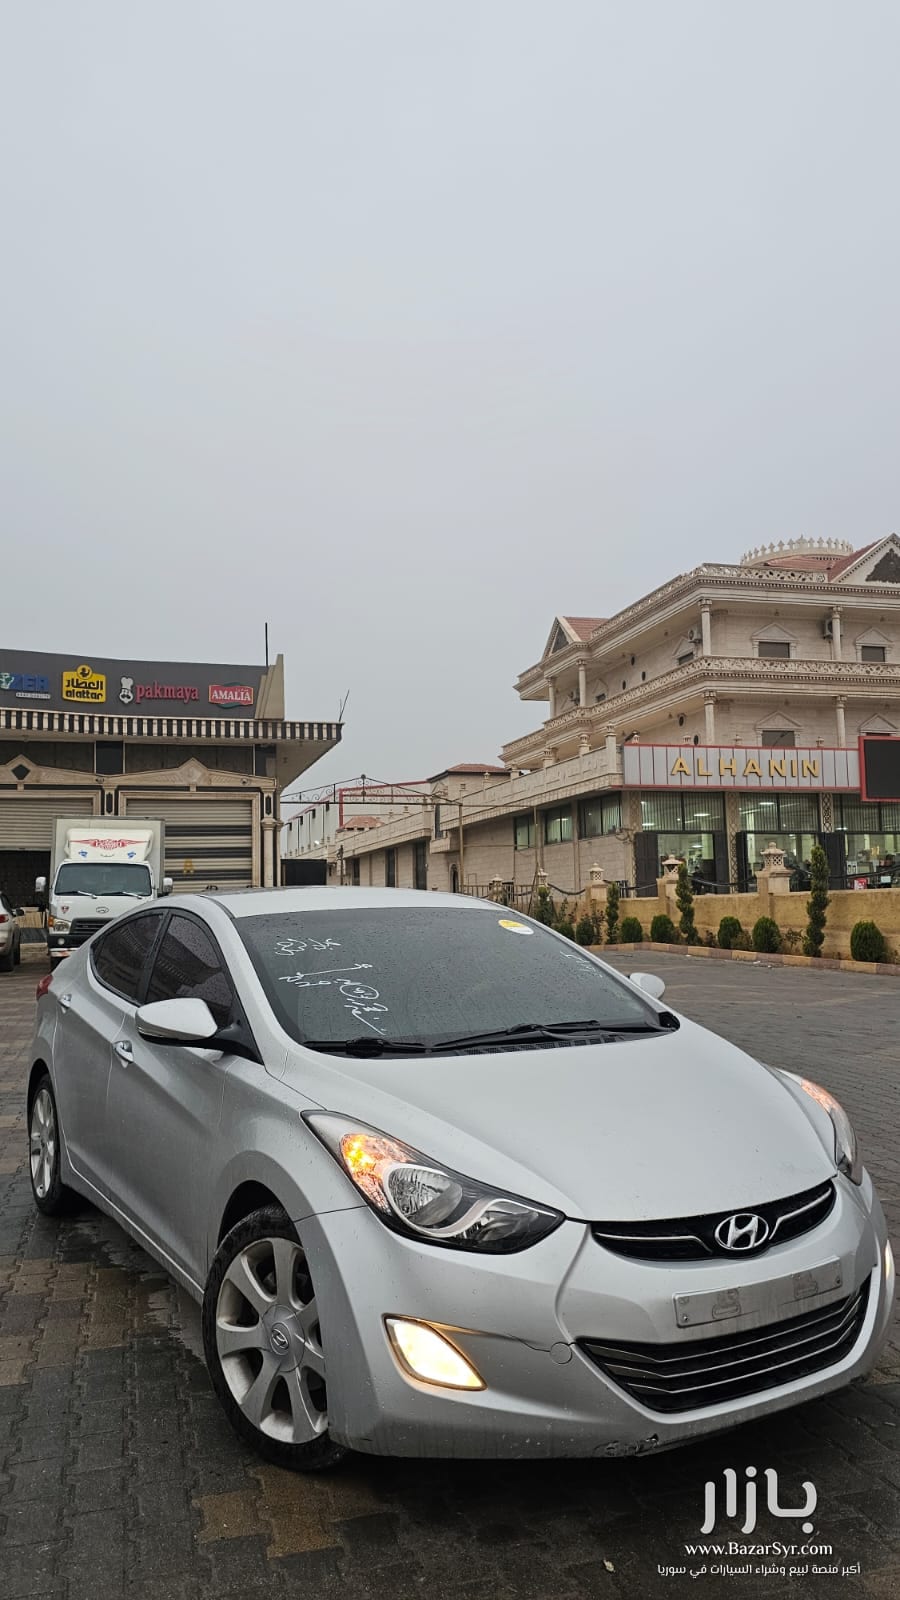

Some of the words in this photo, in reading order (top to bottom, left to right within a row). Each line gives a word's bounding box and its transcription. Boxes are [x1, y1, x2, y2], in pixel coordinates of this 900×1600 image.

[65, 678, 103, 690] العطار
[65, 689, 103, 700] alattar
[135, 680, 199, 704] pakmaya
[212, 689, 251, 701] AMALIA
[671, 757, 820, 778] ALHANIN
